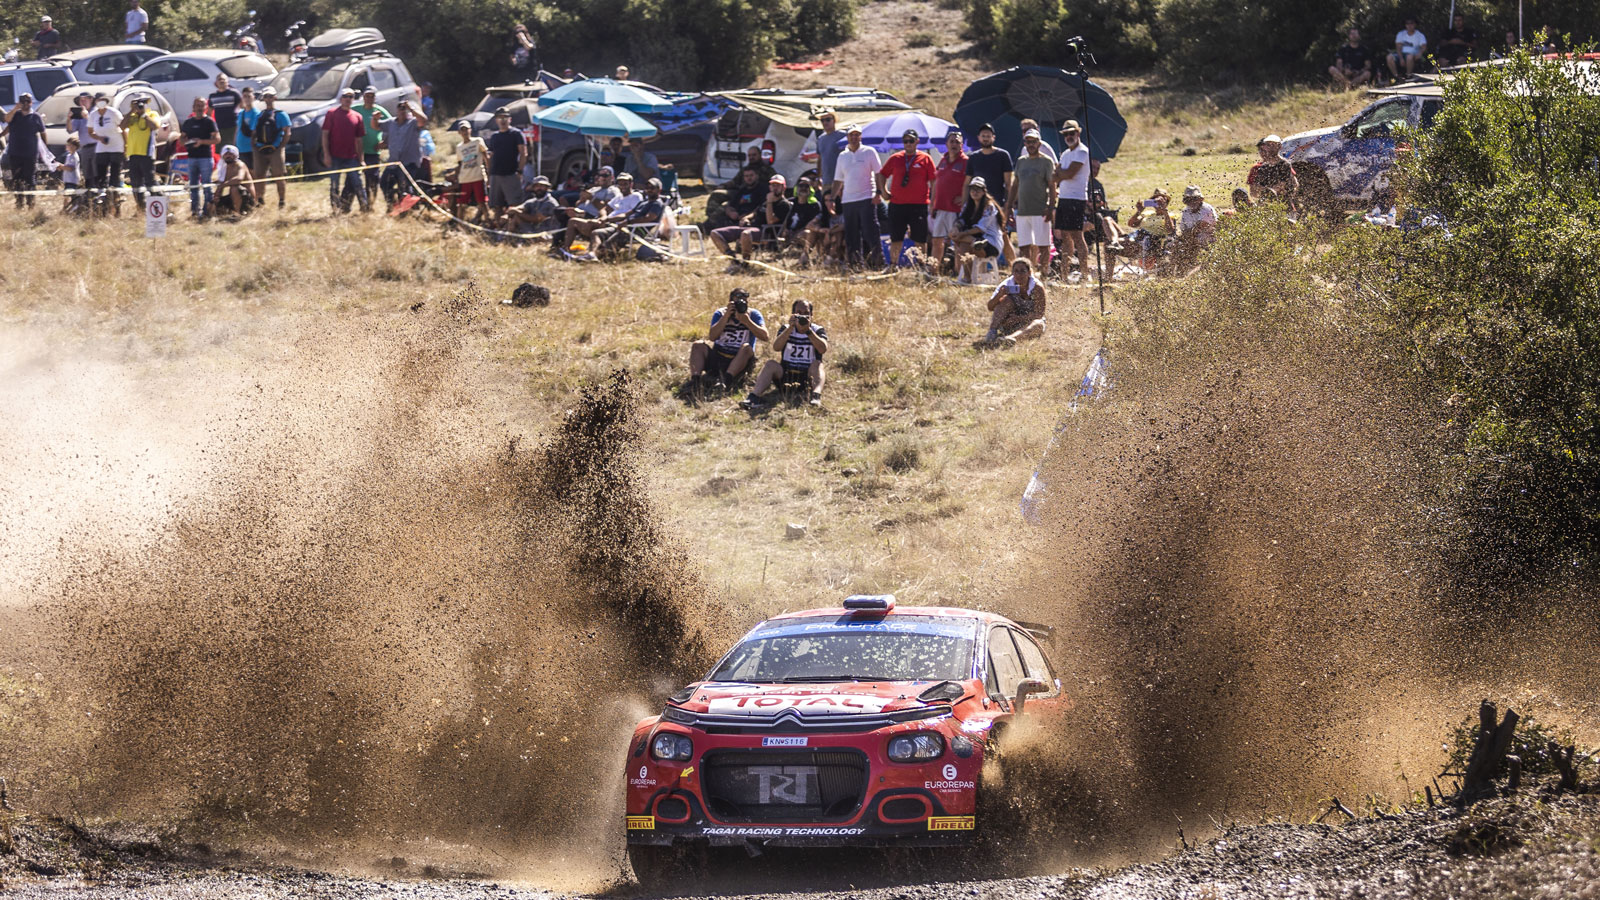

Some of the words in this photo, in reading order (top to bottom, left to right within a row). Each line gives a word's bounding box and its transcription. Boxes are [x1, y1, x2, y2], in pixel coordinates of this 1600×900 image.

[790, 345, 810, 359] 221
[732, 695, 864, 708] TOTAL
[924, 781, 974, 789] EUROREPAR
[626, 818, 653, 828] PIRELLI
[931, 818, 974, 829] PIRELLI
